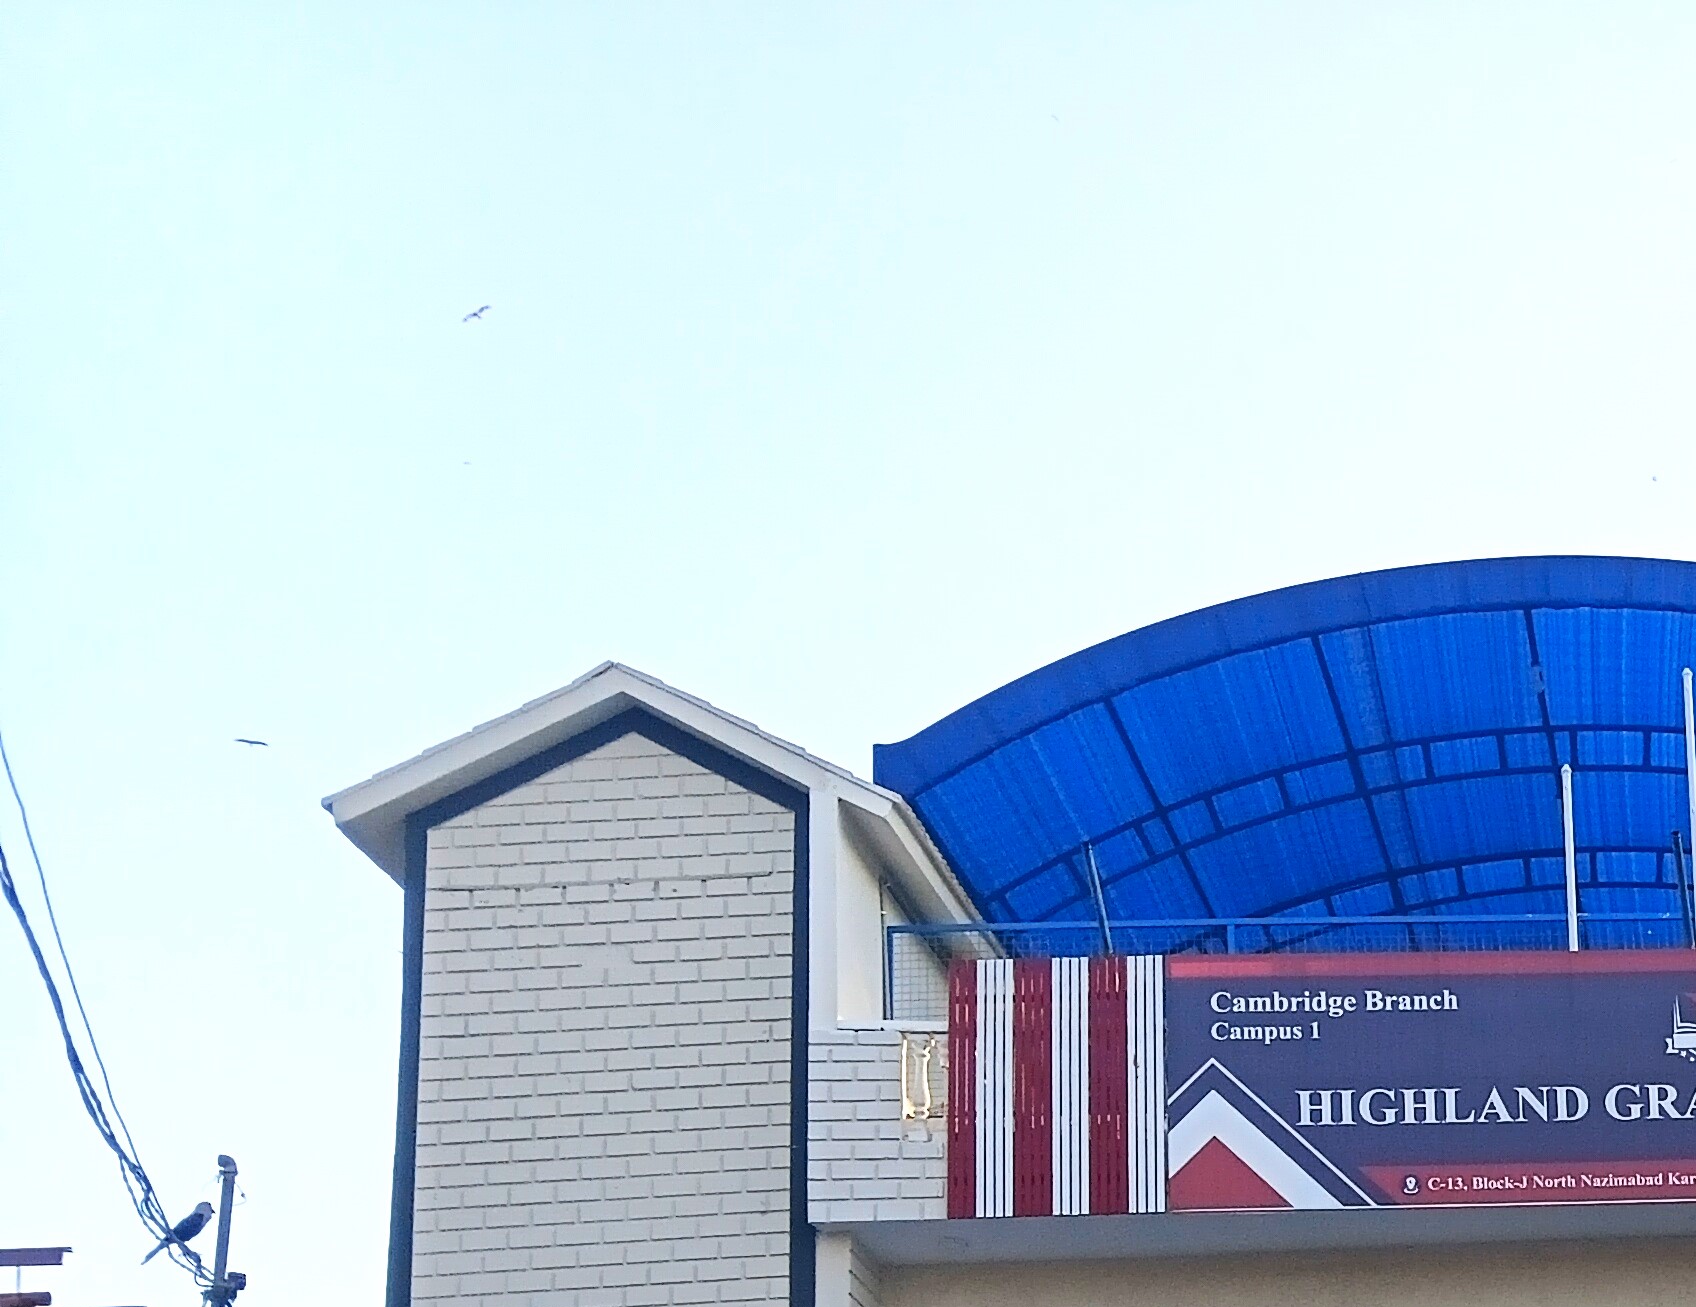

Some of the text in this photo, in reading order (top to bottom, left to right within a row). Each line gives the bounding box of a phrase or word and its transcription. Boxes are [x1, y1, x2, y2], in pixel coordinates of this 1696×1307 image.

[1210, 989, 1459, 1018] Cambridge Branch
[1210, 1021, 1321, 1045] Campus 1
[1295, 1086, 1589, 1126] HIGHLAND
[1427, 1176, 1468, 1191] C-13,
[1472, 1175, 1528, 1190] Block-J
[1532, 1174, 1576, 1188] North
[1580, 1172, 1663, 1187] Nazimabad
